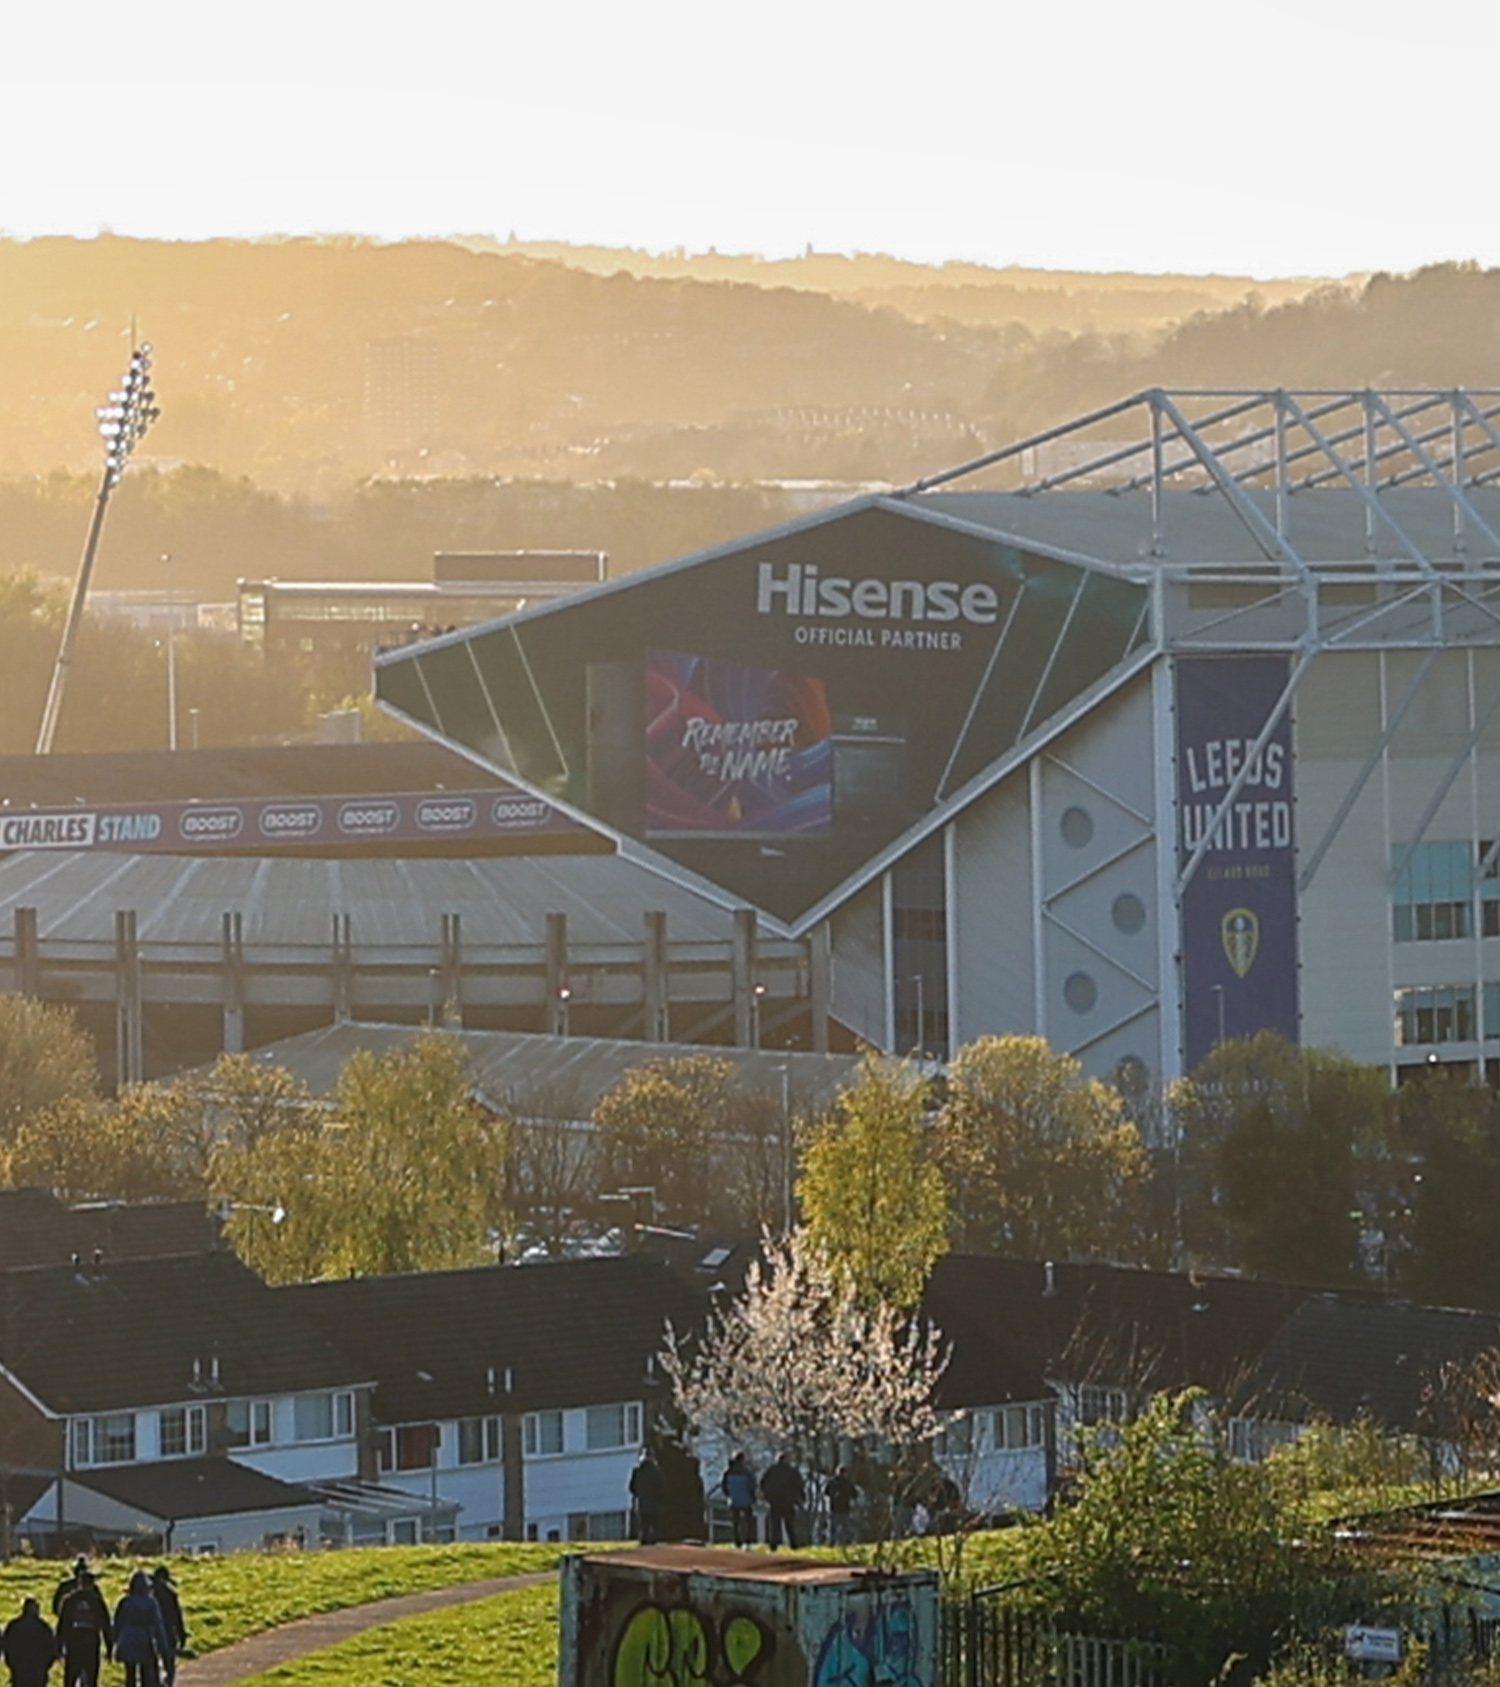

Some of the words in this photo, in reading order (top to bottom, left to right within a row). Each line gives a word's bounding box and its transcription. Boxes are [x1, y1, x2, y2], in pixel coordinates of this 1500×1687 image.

[757, 562, 998, 624] Hisense
[794, 627, 874, 647] OFFICIAL
[881, 629, 962, 650] PARTNER
[682, 717, 799, 753] REMEMBER
[1186, 738, 1285, 793] LEEDS
[264, 811, 317, 828] BOOST
[343, 808, 395, 825] BOOST
[420, 806, 471, 822] BOOST
[497, 802, 546, 818] BOOST
[3, 816, 89, 845] CHARLES
[99, 814, 161, 841] STAND
[185, 814, 237, 832] BOOST
[1184, 801, 1290, 851] UNITED
